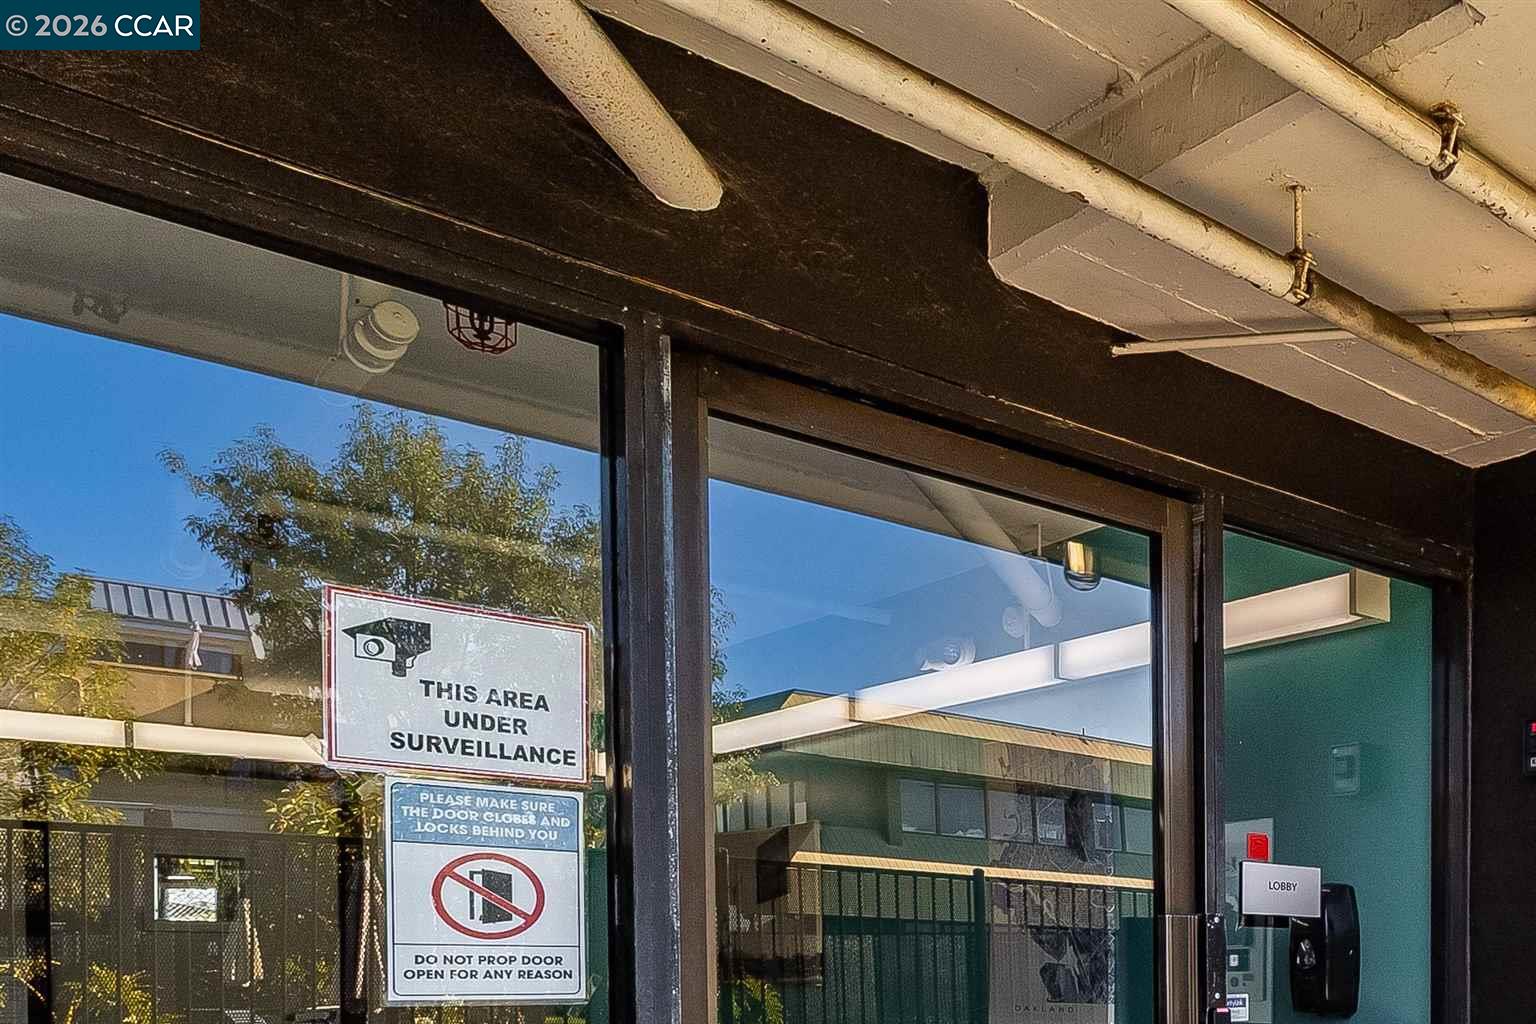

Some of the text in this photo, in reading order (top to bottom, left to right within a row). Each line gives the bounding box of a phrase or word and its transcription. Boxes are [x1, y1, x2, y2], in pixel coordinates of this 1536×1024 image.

[419, 679, 550, 712] THIS AREA
[444, 709, 528, 736] UNDER
[390, 731, 577, 766] SURVEILLANCE
[420, 792, 555, 813] PLEASE MAKE SURE
[401, 805, 428, 818] THE
[432, 807, 479, 821] DOOR
[540, 816, 570, 828] AND
[415, 821, 558, 841] LOCKS BEHIND YOU
[1269, 880, 1298, 892] LOBBY
[414, 955, 563, 966] DO NOT PROP DOOR
[403, 969, 573, 980] OPEN FOR ANY REASON
